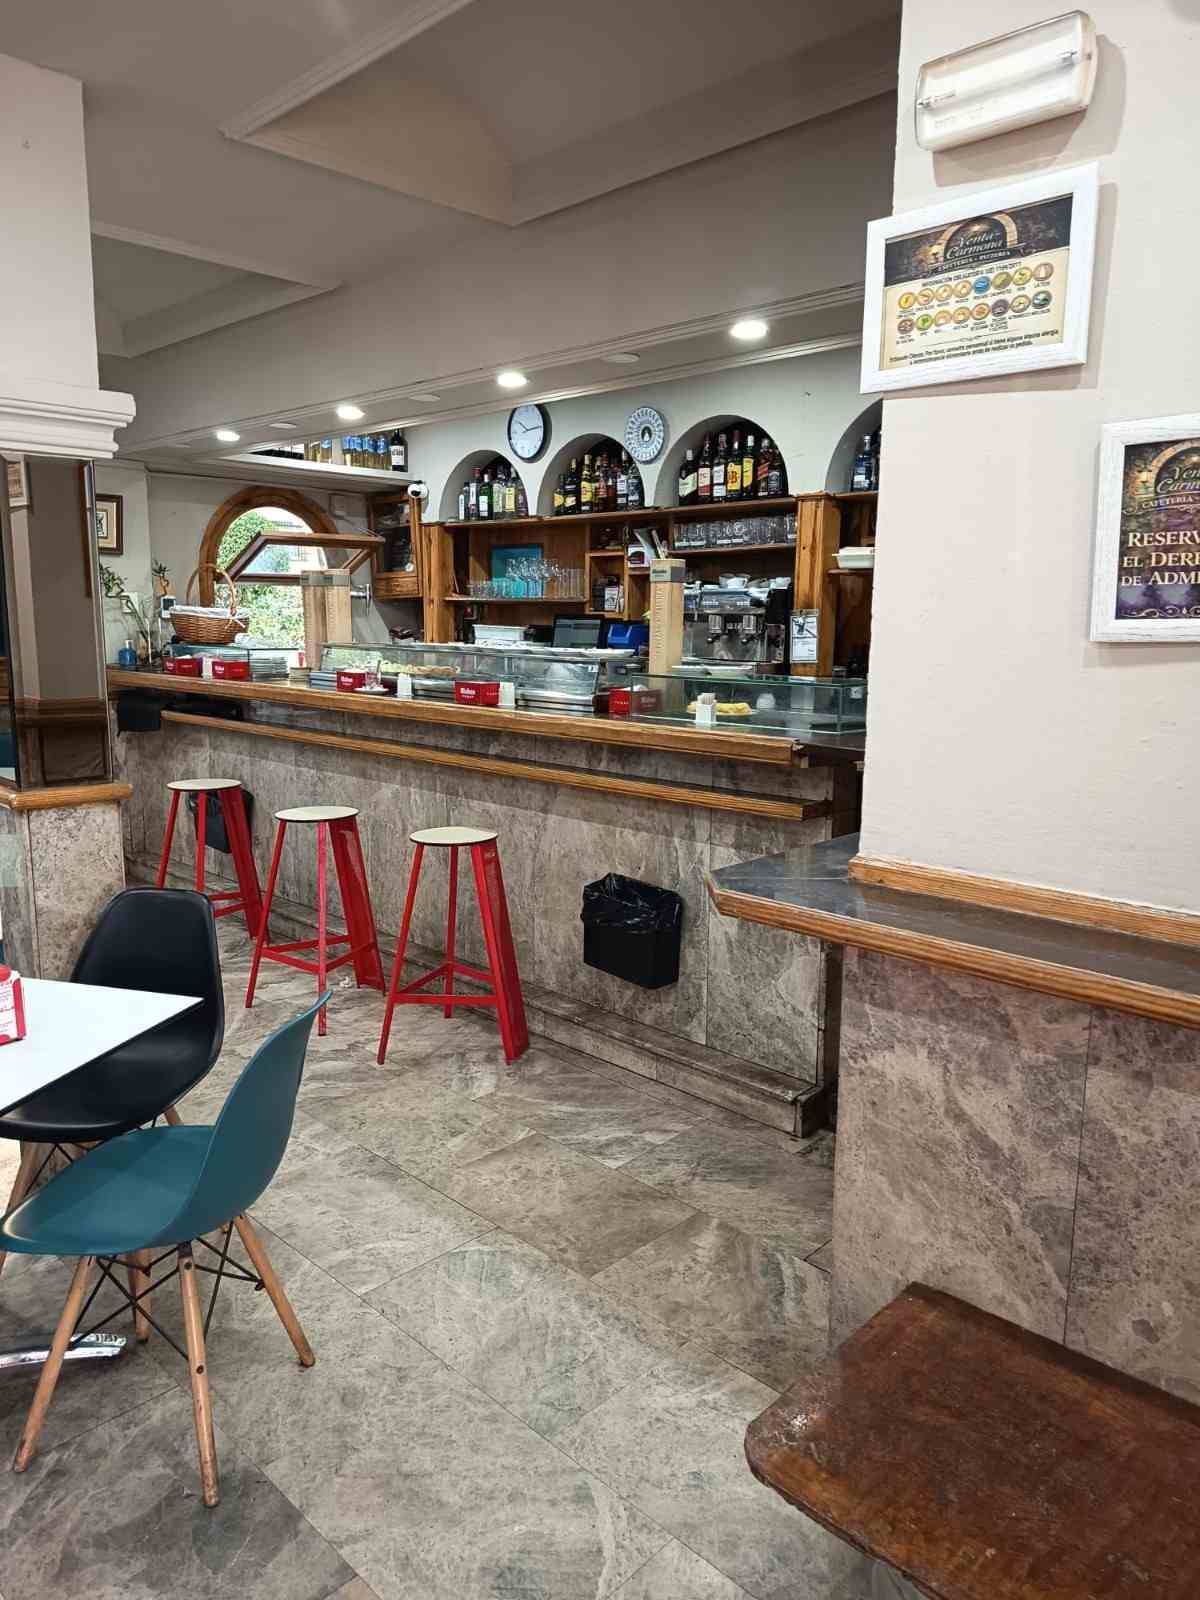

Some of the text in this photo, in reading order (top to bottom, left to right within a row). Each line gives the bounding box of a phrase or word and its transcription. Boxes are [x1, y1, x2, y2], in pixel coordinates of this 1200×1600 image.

[946, 240, 1003, 259] Carmona
[1123, 556, 1143, 568] EL
[1121, 575, 1142, 586] DE
